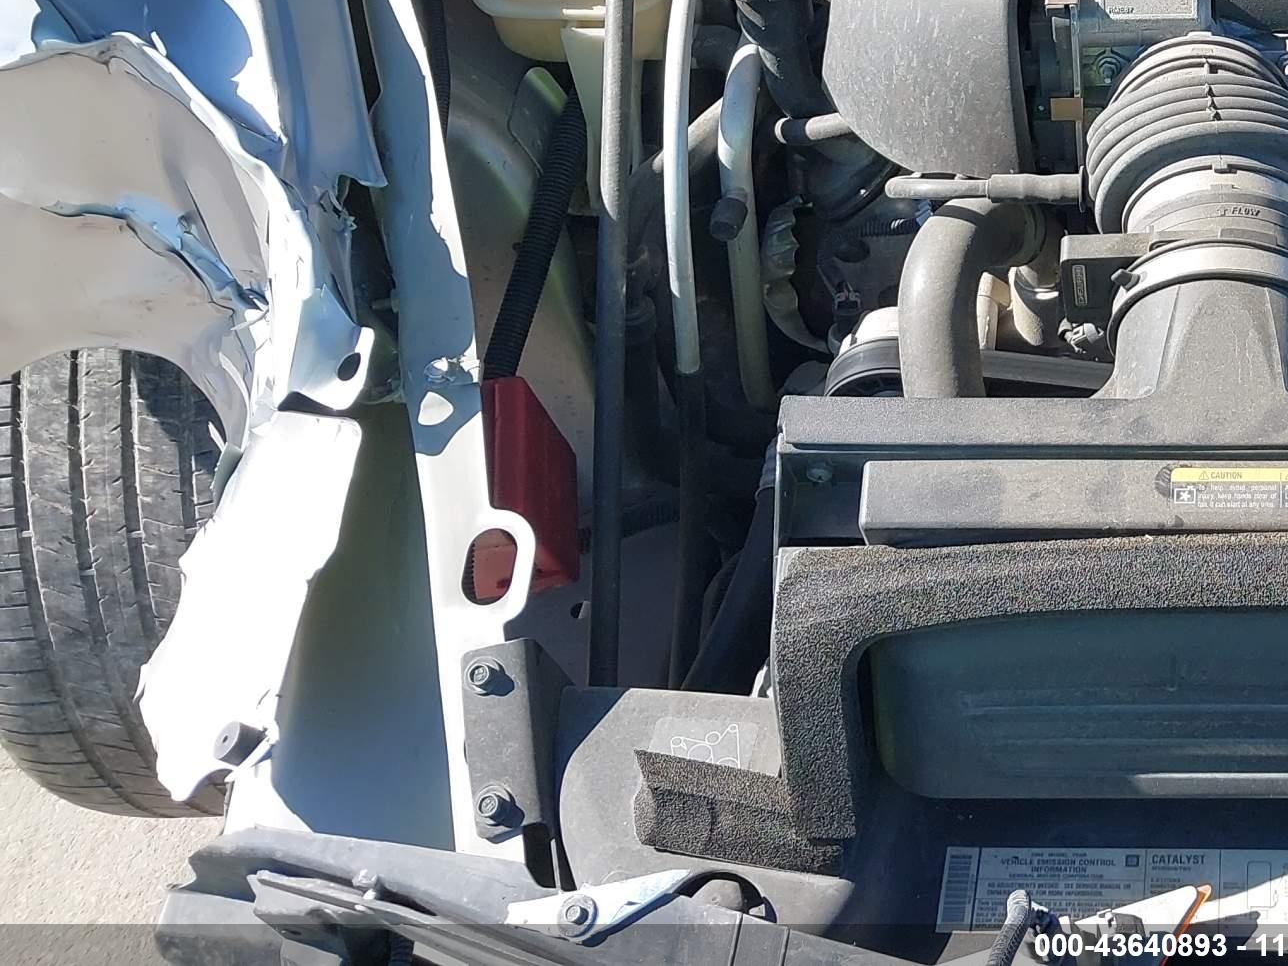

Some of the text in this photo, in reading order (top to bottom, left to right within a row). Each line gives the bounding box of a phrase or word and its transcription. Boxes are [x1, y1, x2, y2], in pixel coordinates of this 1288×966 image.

[1232, 206, 1261, 217] FLOW
[1210, 471, 1243, 480] CAUTION
[1001, 857, 1117, 867] VEHICLE EMISSION CONTROL
[1151, 854, 1207, 865] CATALYST
[1031, 866, 1088, 874] INFORMATION
